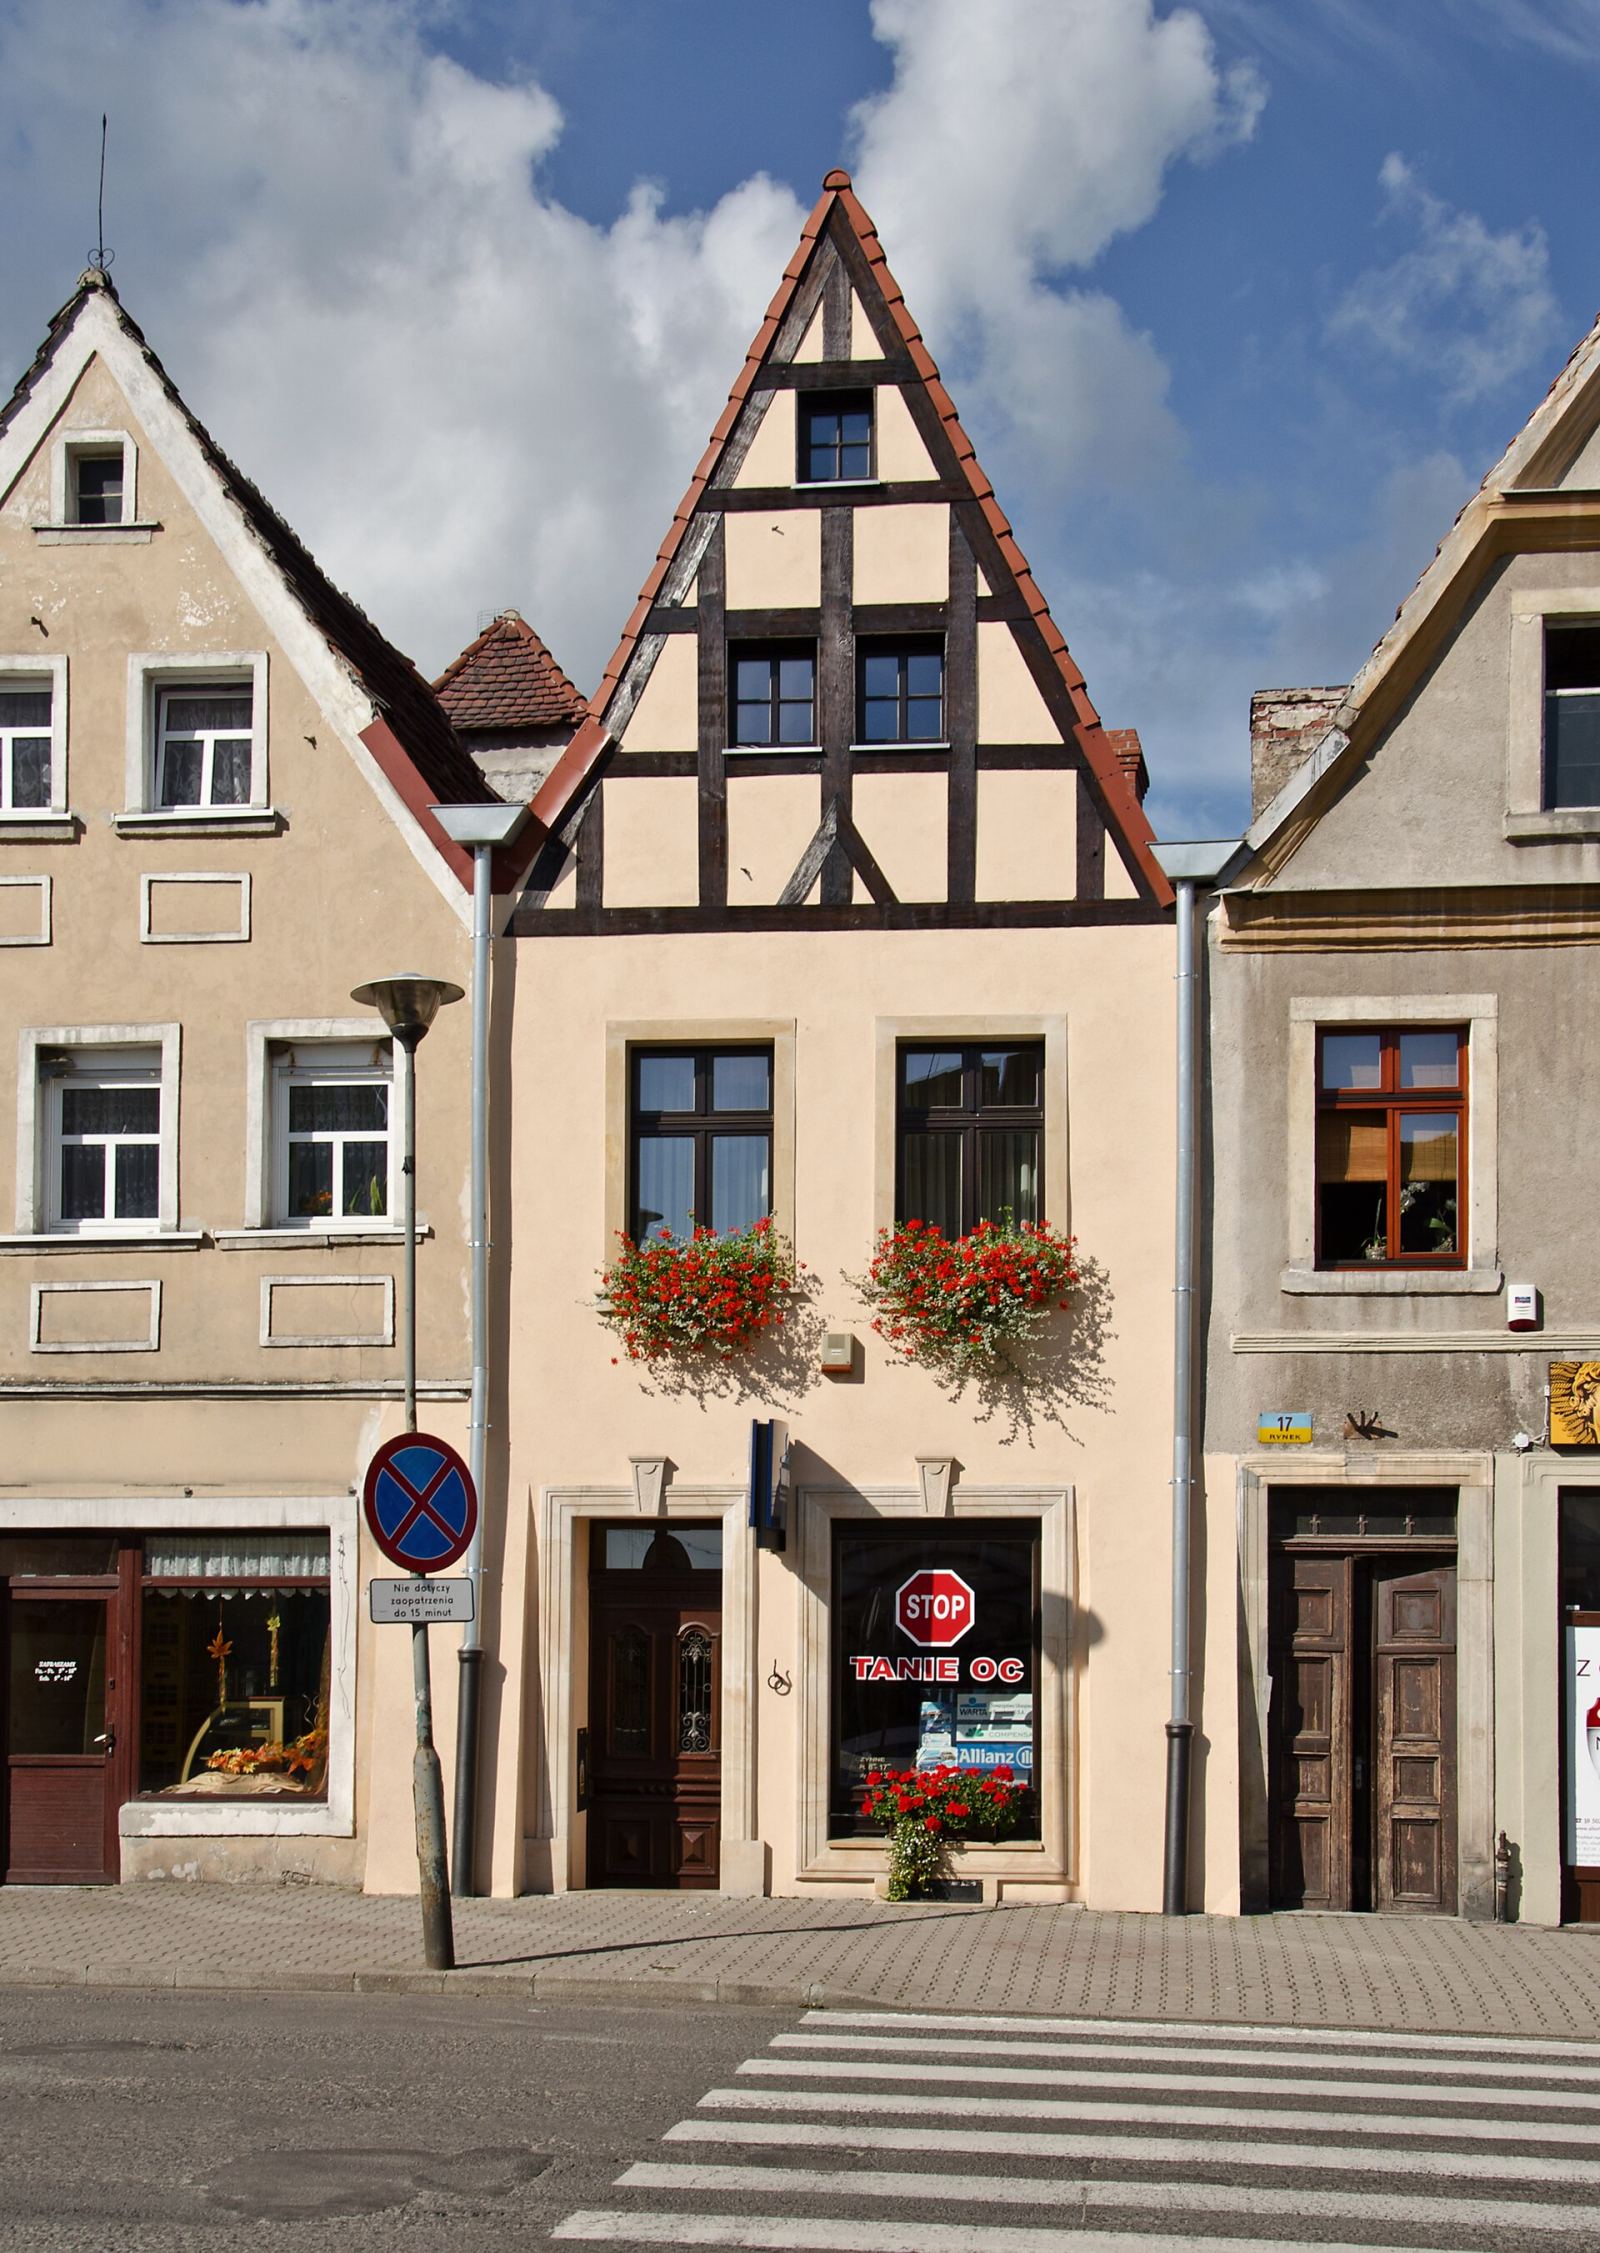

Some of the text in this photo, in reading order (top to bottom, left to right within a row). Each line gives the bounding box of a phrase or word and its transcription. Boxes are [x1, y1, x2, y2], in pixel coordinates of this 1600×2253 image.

[1277, 1416, 1293, 1432] 17
[393, 1584, 451, 1594] Nie dotyczy
[391, 1597, 454, 1607] zaopatrzenia
[906, 1594, 965, 1620] STOP
[394, 1609, 452, 1618] do 15 minut
[849, 1656, 1025, 1683] TANIE OC
[959, 1708, 988, 1716] WARTA
[959, 1748, 1015, 1764] Allianz
